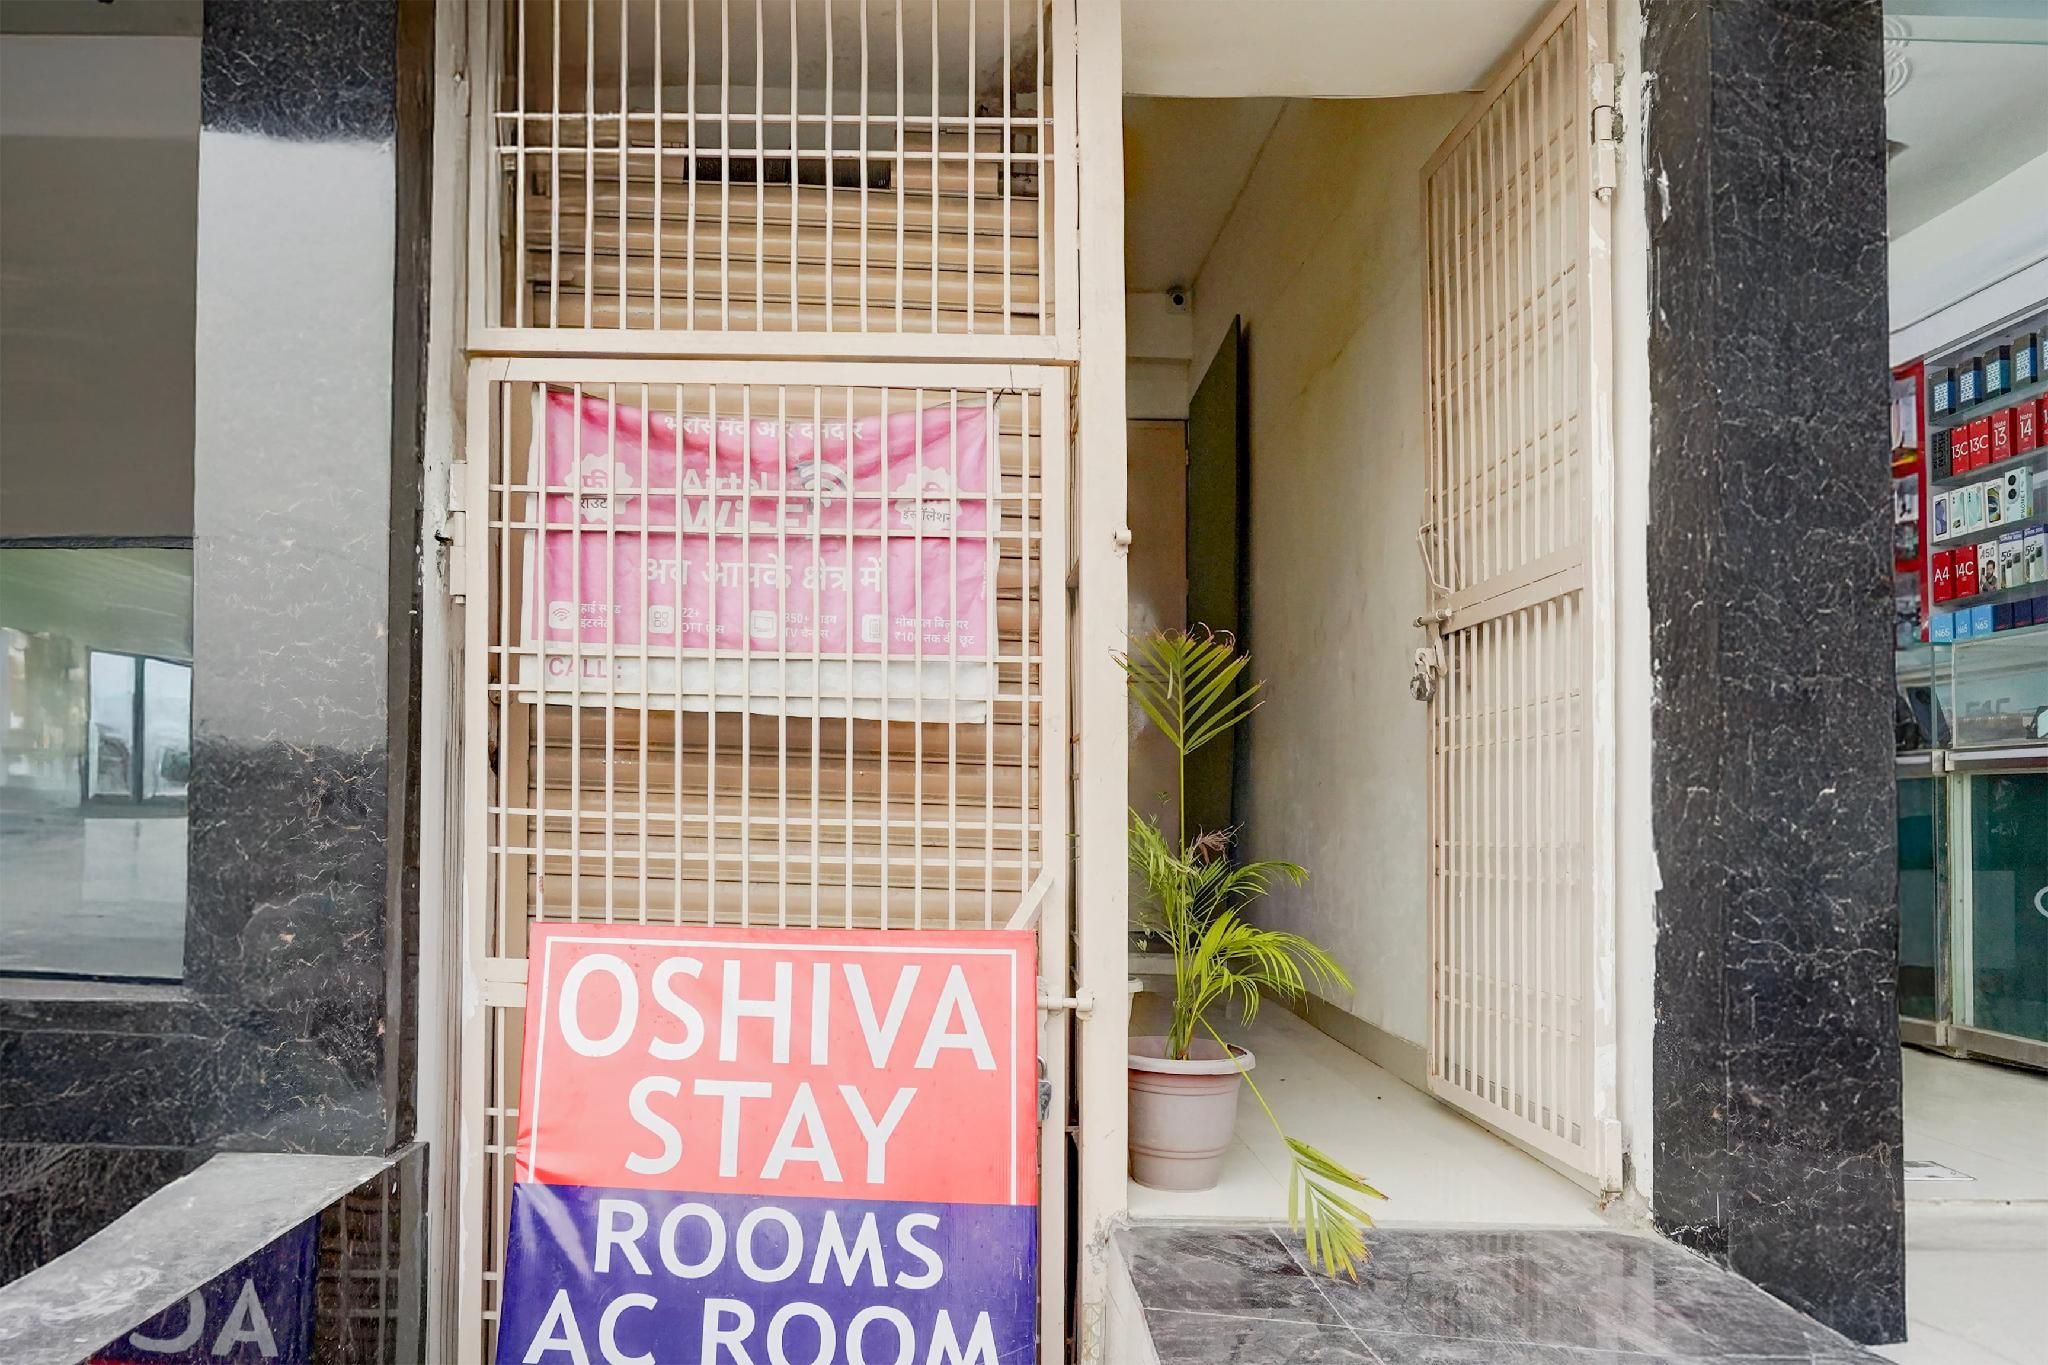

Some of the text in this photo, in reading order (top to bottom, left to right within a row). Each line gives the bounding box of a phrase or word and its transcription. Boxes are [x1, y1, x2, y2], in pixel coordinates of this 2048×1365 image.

[800, 422, 864, 440] दमदर
[1994, 427, 2007, 447] 13
[2020, 418, 2033, 439] 14
[1952, 442, 1969, 459] 13C
[1970, 435, 1989, 453] 13C
[580, 497, 609, 509] राउट
[1934, 567, 1950, 583] A4
[1955, 562, 1974, 578] 14C
[895, 614, 931, 628] मोबाल
[558, 953, 998, 1071] OSHIVA
[624, 1075, 918, 1185] STAY
[594, 1198, 944, 1290] ROOMS
[523, 1288, 999, 1365] AC ROOM
